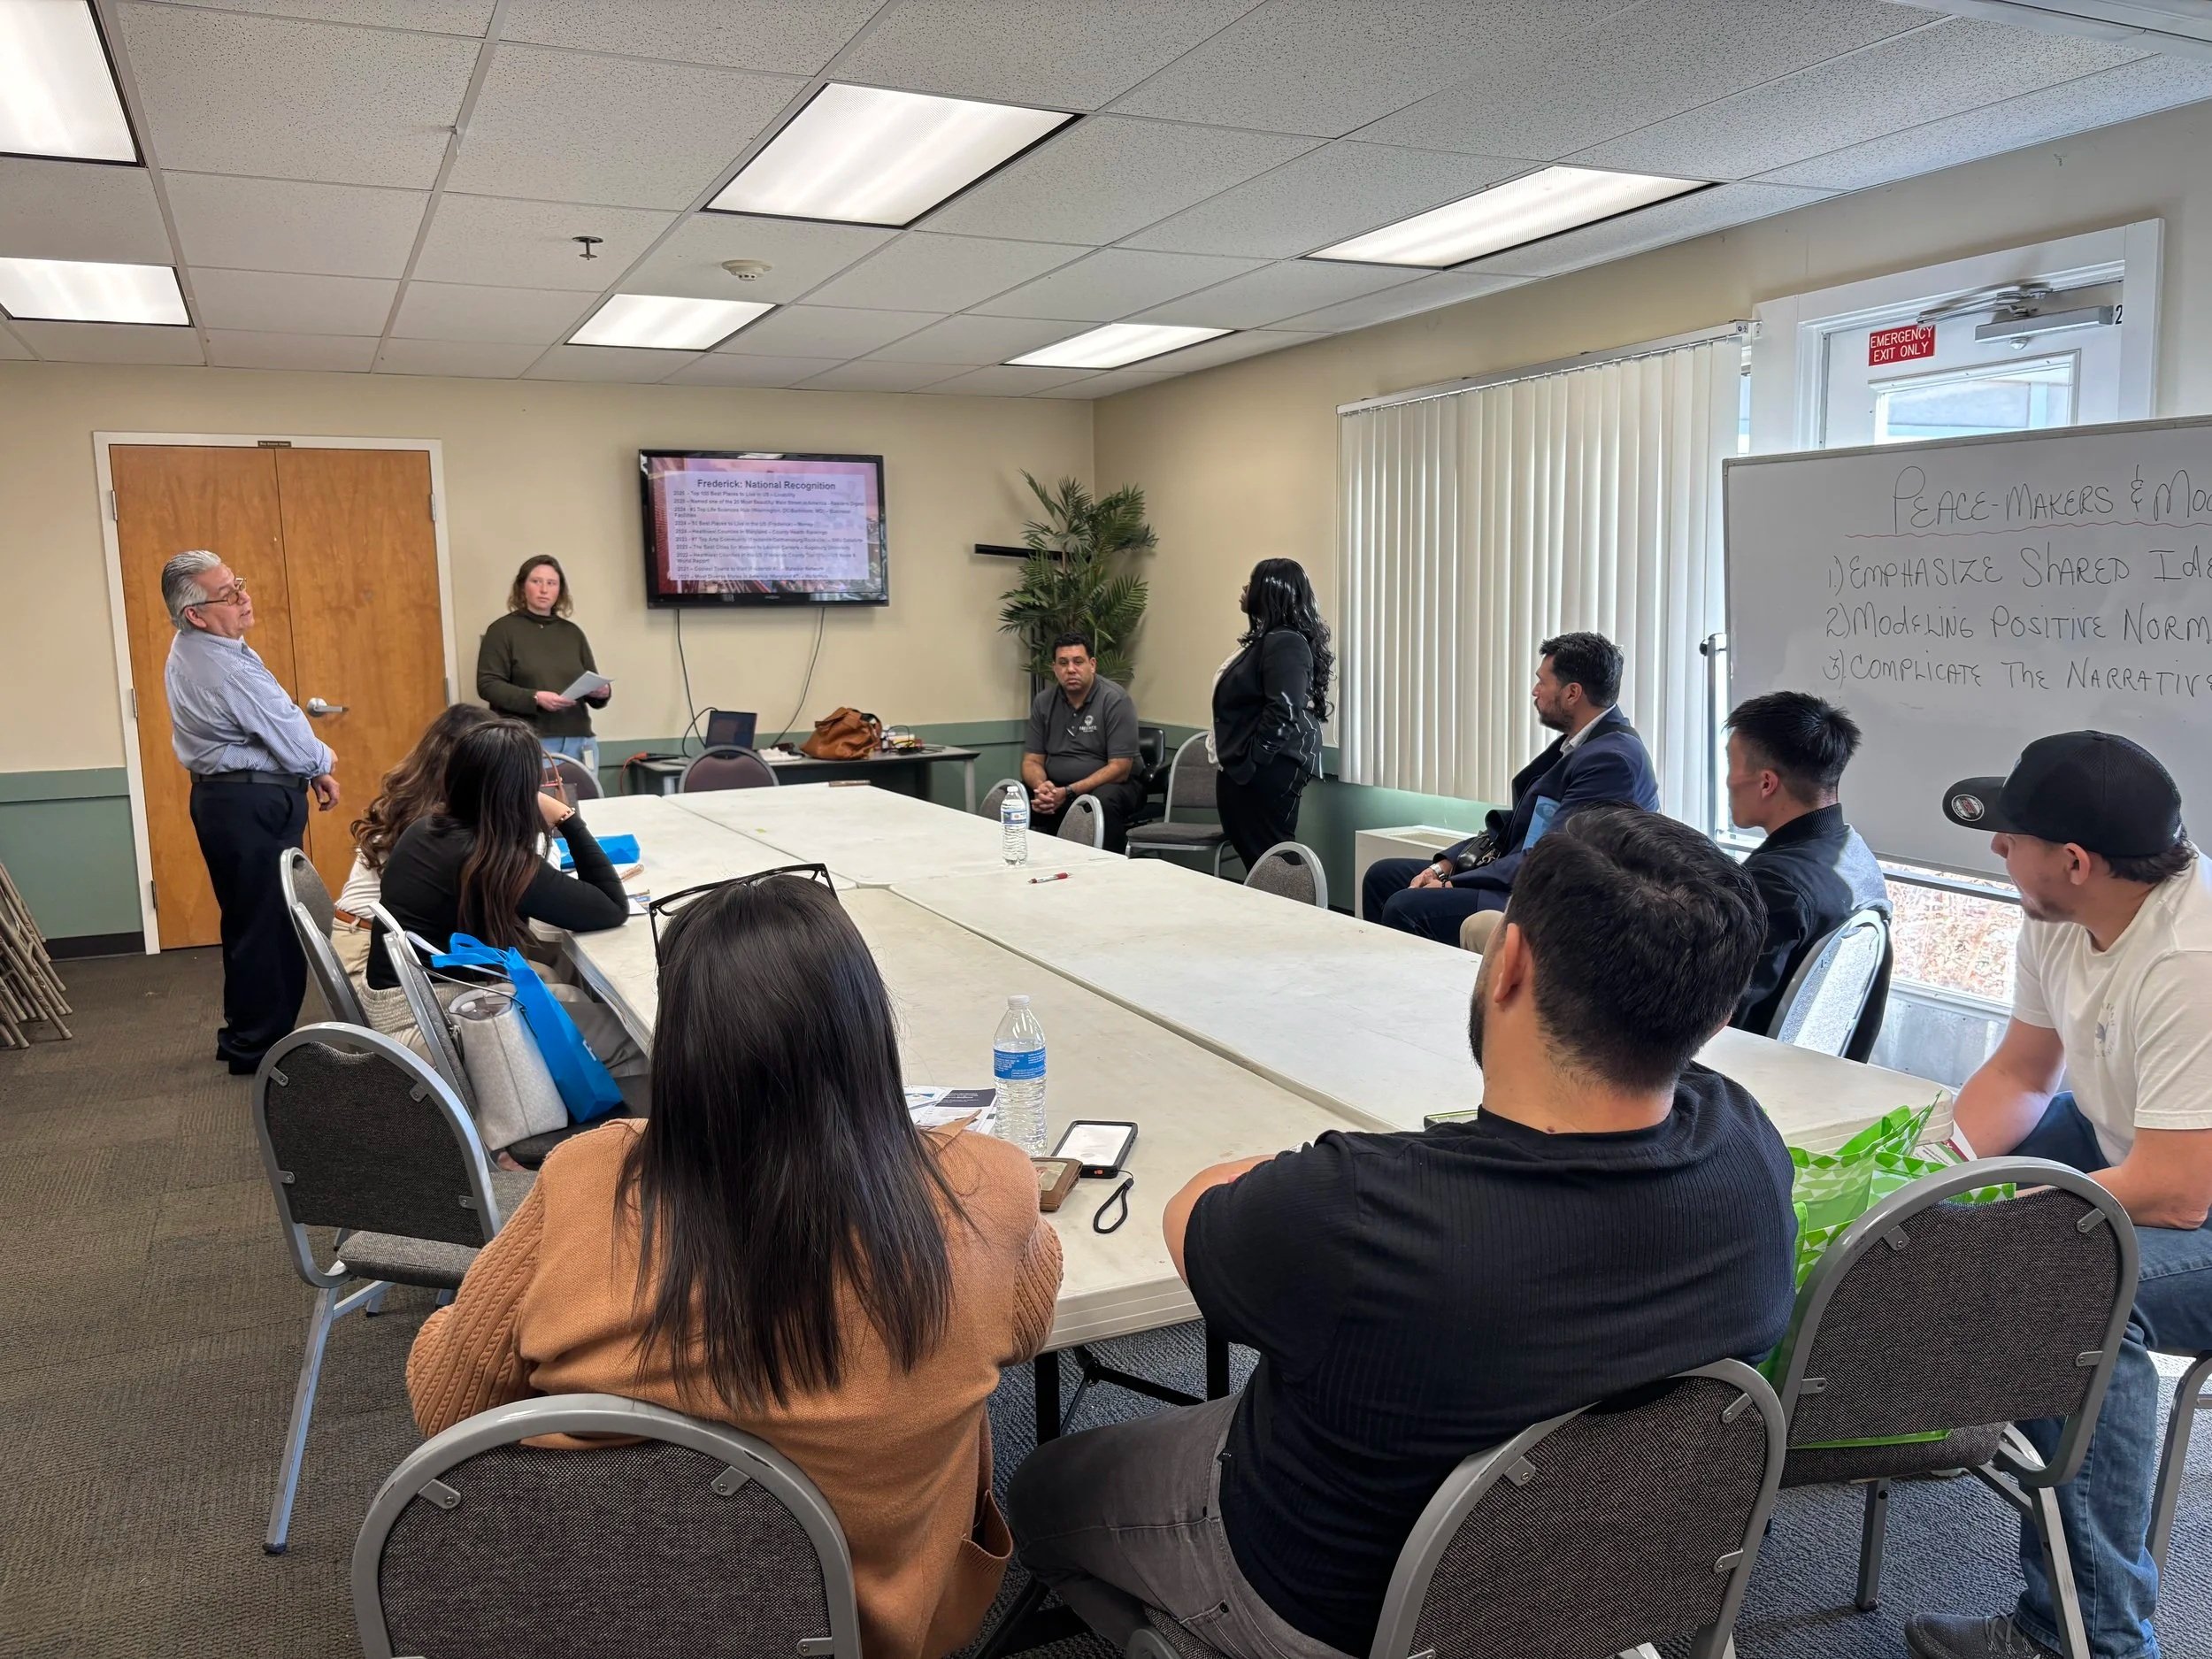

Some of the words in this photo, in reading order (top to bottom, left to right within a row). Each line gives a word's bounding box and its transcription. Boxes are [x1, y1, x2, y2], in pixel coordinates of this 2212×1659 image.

[2115, 303, 2123, 325] 2
[1870, 326, 1933, 349] EMERGENCY
[1873, 346, 1896, 363] EXIT
[1900, 341, 1929, 357] ONLY
[697, 479, 743, 488] Frederick:
[745, 480, 782, 489] National
[784, 481, 836, 492] Recognition
[1893, 465, 2114, 534] PEACE-MAKERS
[1849, 556, 2003, 588] EMPHASIZE
